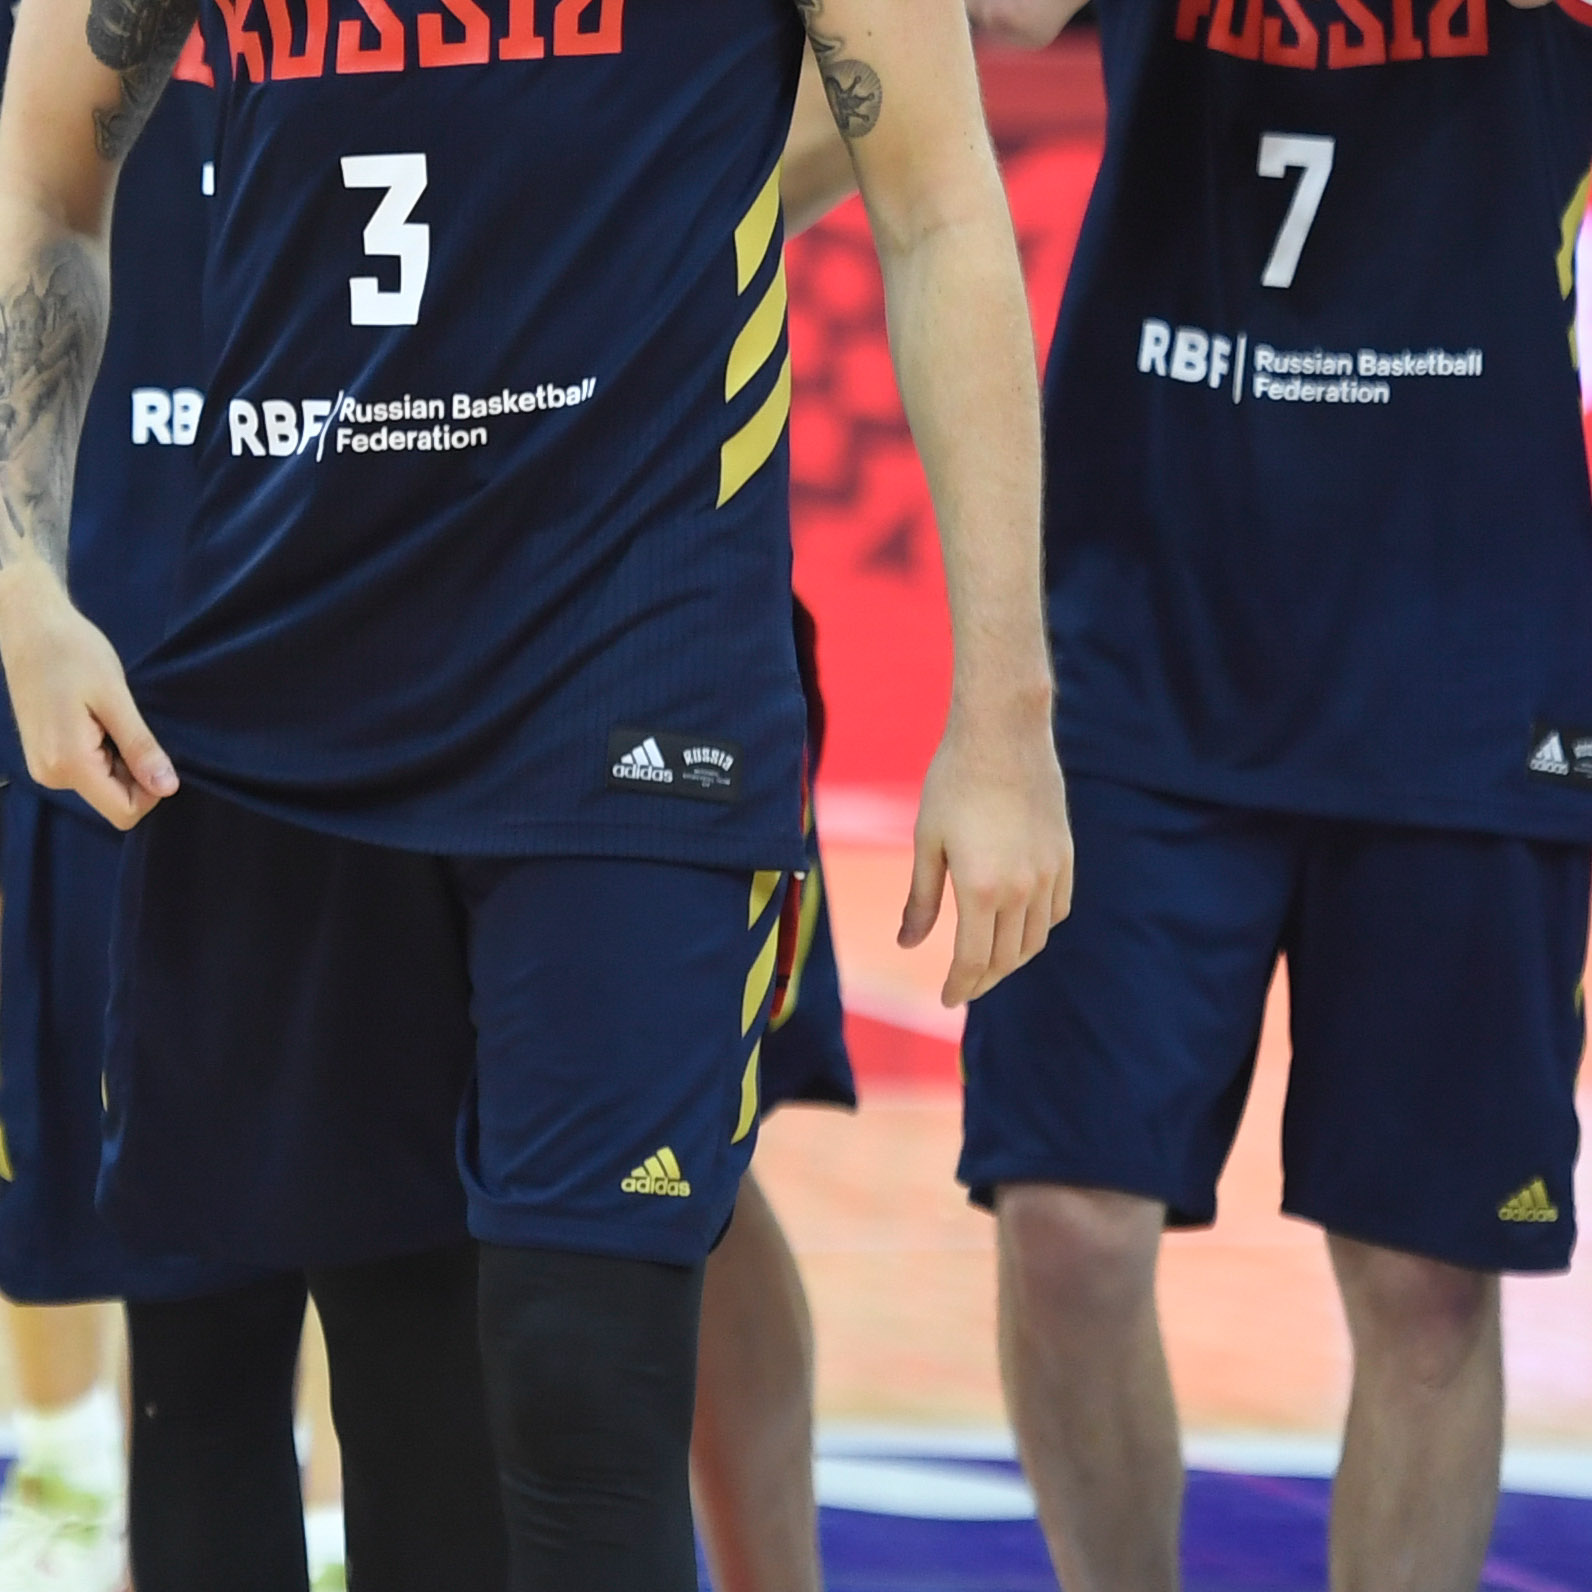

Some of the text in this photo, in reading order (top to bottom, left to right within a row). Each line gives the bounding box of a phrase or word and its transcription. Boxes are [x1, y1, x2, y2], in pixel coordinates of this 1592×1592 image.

[1256, 132, 1336, 289] 7
[340, 152, 431, 327] 3
[1137, 319, 1232, 389] RBF
[1254, 344, 1483, 377] Russian Basketball
[339, 377, 597, 423] Russian Basketball
[1253, 373, 1390, 404] Federation
[131, 387, 205, 446] RB
[228, 398, 333, 458] RBF
[336, 424, 488, 454] Federation
[612, 763, 673, 783] adidas
[622, 1174, 691, 1197] adidas
[1498, 1206, 1558, 1223] adidas
